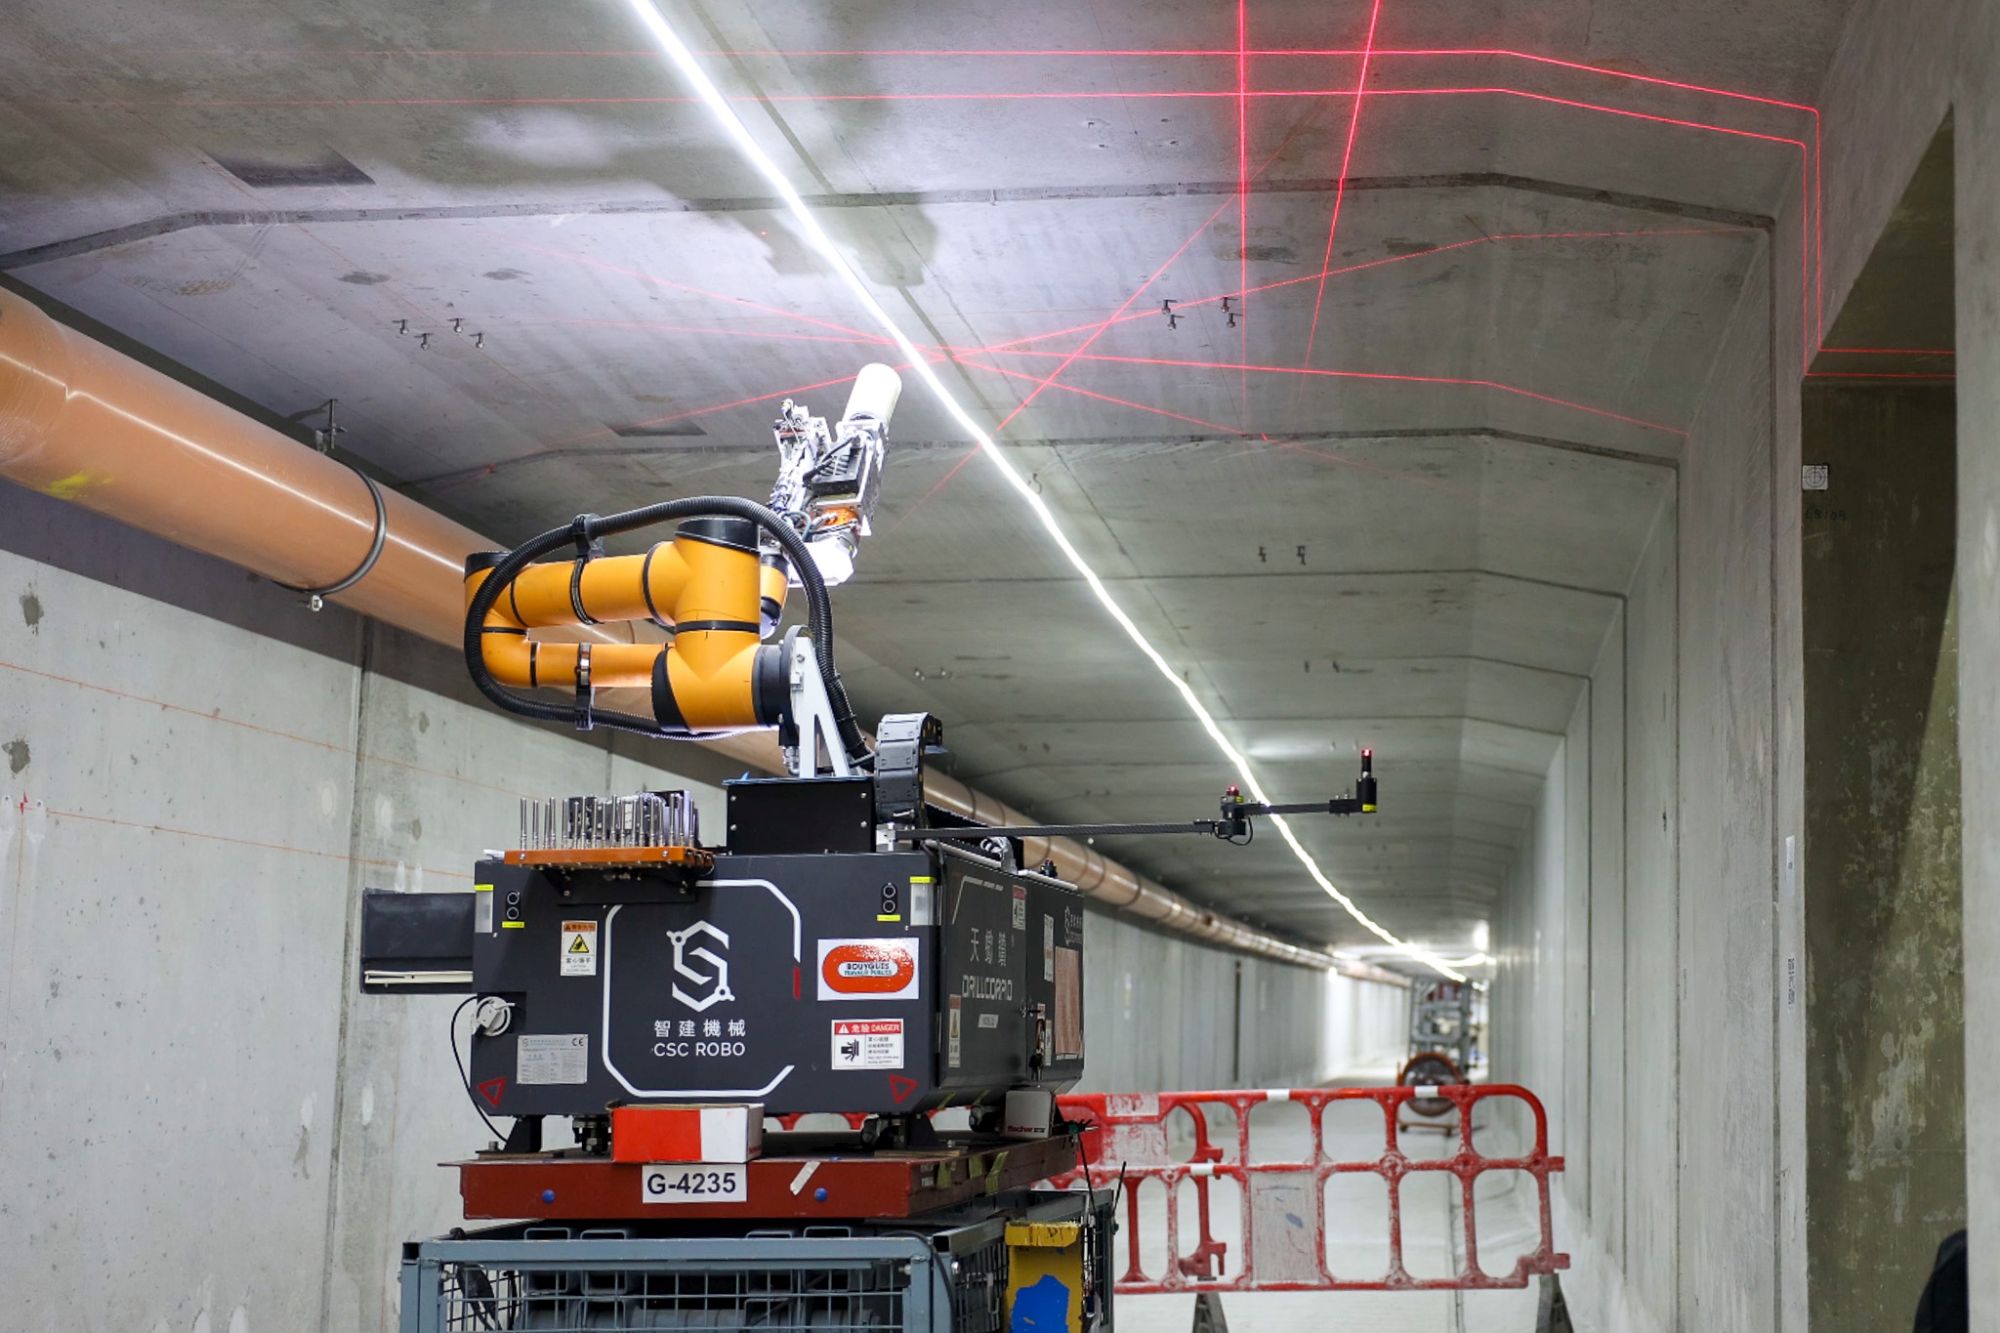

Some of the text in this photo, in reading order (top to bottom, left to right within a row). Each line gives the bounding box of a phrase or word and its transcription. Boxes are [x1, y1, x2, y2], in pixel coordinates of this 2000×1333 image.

[654, 1019, 746, 1037] 智建機械
[871, 1023, 900, 1032] DANGER
[571, 1037, 584, 1047] CE
[653, 1042, 746, 1057] CSC ROBO
[647, 1172, 736, 1194] G-4235
